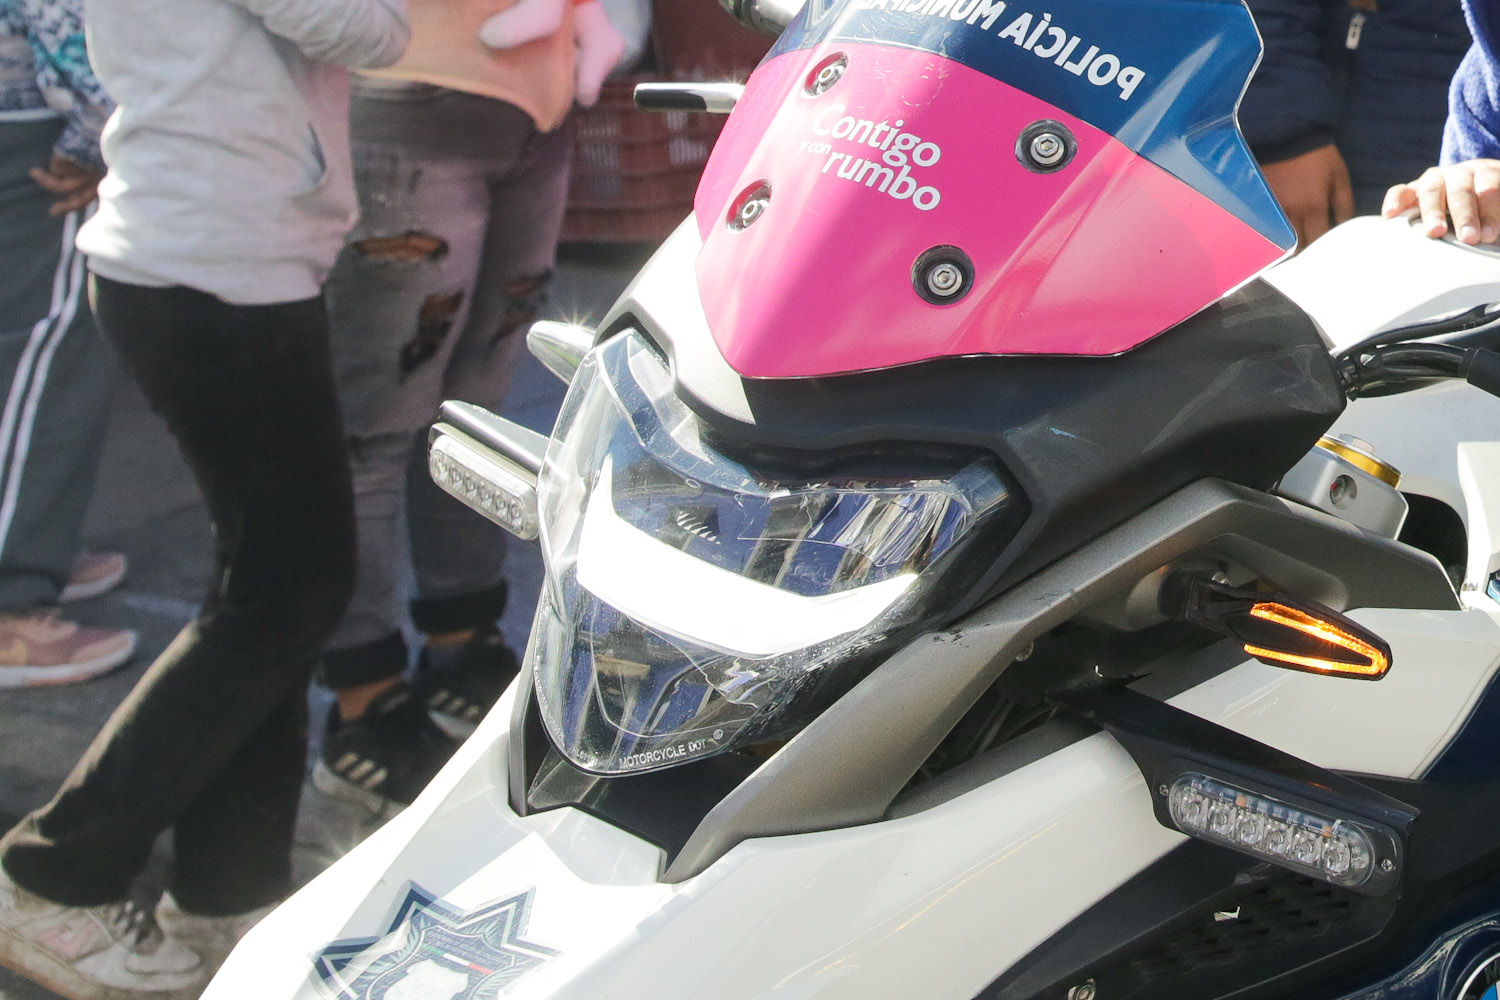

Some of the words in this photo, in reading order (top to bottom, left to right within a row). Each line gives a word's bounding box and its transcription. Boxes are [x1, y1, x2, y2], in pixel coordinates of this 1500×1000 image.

[812, 104, 941, 167] Contigo
[808, 142, 832, 155] con
[821, 151, 941, 211] rumbo
[619, 745, 687, 769] MOTORCYCLE
[688, 738, 706, 752] DOT
